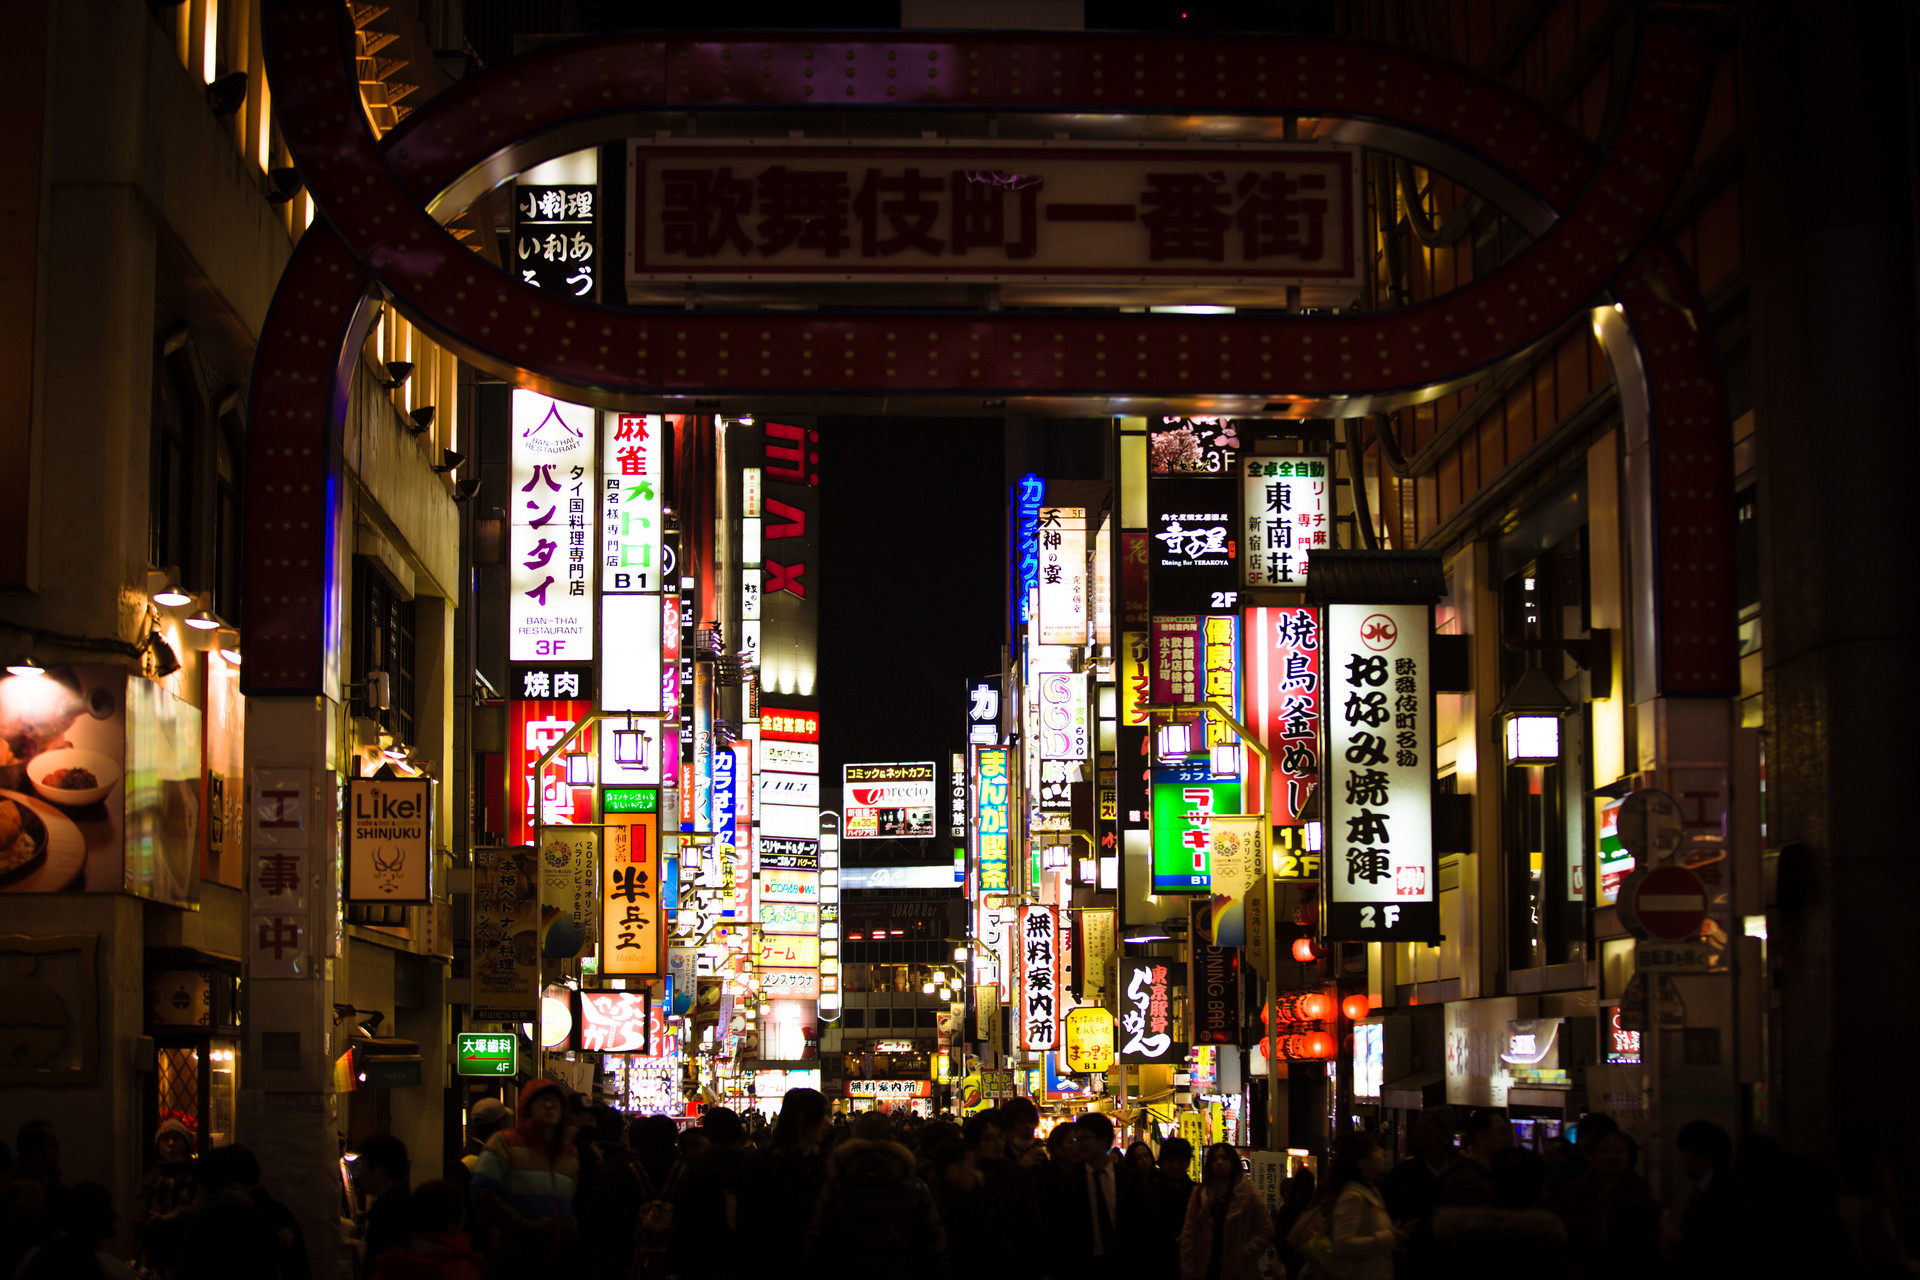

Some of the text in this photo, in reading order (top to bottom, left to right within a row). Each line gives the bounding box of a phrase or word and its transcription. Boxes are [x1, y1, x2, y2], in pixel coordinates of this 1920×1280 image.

[520, 190, 593, 220] 小料理
[661, 165, 1328, 264] 歌舞伎町一番街
[525, 441, 581, 454] RESTAURANT
[532, 437, 575, 447] BAN-THAI
[614, 414, 649, 475] 麻雀
[1206, 451, 1236, 472] 3F
[1248, 462, 1325, 478] 全卓全自動
[606, 479, 620, 567] 四名様専門店
[1313, 481, 1326, 550] リーチ麻
[521, 464, 562, 607] バンタイ
[569, 465, 585, 597] タイ国料理専門店
[1248, 516, 1262, 570] 新宿店
[1265, 482, 1294, 584] 東南荘
[1043, 509, 1062, 584] 天神の宴
[615, 573, 647, 588] B1
[1248, 572, 1263, 583] 3F
[1211, 592, 1238, 607] 2F
[518, 627, 584, 635] RESTAURANT
[526, 617, 578, 625] BAN-THAI
[536, 640, 566, 656] 3F
[1159, 636, 1171, 681] ホテル可
[1171, 636, 1183, 695] 飲食店検索
[523, 671, 580, 698] 焼肉
[761, 716, 817, 734] 全店営業中
[1277, 610, 1318, 818] 焼鳥釜めし
[1395, 658, 1418, 767] 歌舞伎町名物
[847, 767, 932, 779] コミック&ネットカフェ
[1345, 653, 1392, 885] お好み焼本陣
[356, 788, 422, 819] Like!
[952, 774, 965, 825] 北の家族
[356, 828, 422, 841] SHINJUKU
[980, 751, 1007, 889] まんが喫茶
[1183, 788, 1214, 871] ラッキー
[479, 854, 498, 865] 5F
[585, 841, 593, 887] 2020年
[1278, 855, 1319, 877] 2F
[258, 790, 300, 960] 工事中
[1191, 876, 1208, 885] B1
[498, 860, 516, 970] 本格ベトナム料理
[892, 904, 919, 917] LUXOR
[1360, 905, 1400, 928] 2F
[615, 953, 647, 963] Hanbey
[1026, 913, 1053, 1043] 無料案内所
[1206, 944, 1225, 1030] DINING BAR
[1150, 965, 1169, 1034] 東京豚骨
[463, 1039, 512, 1053] 大塚歯科
[496, 1063, 510, 1072] 4F
[850, 1081, 917, 1093] 無料案内所
